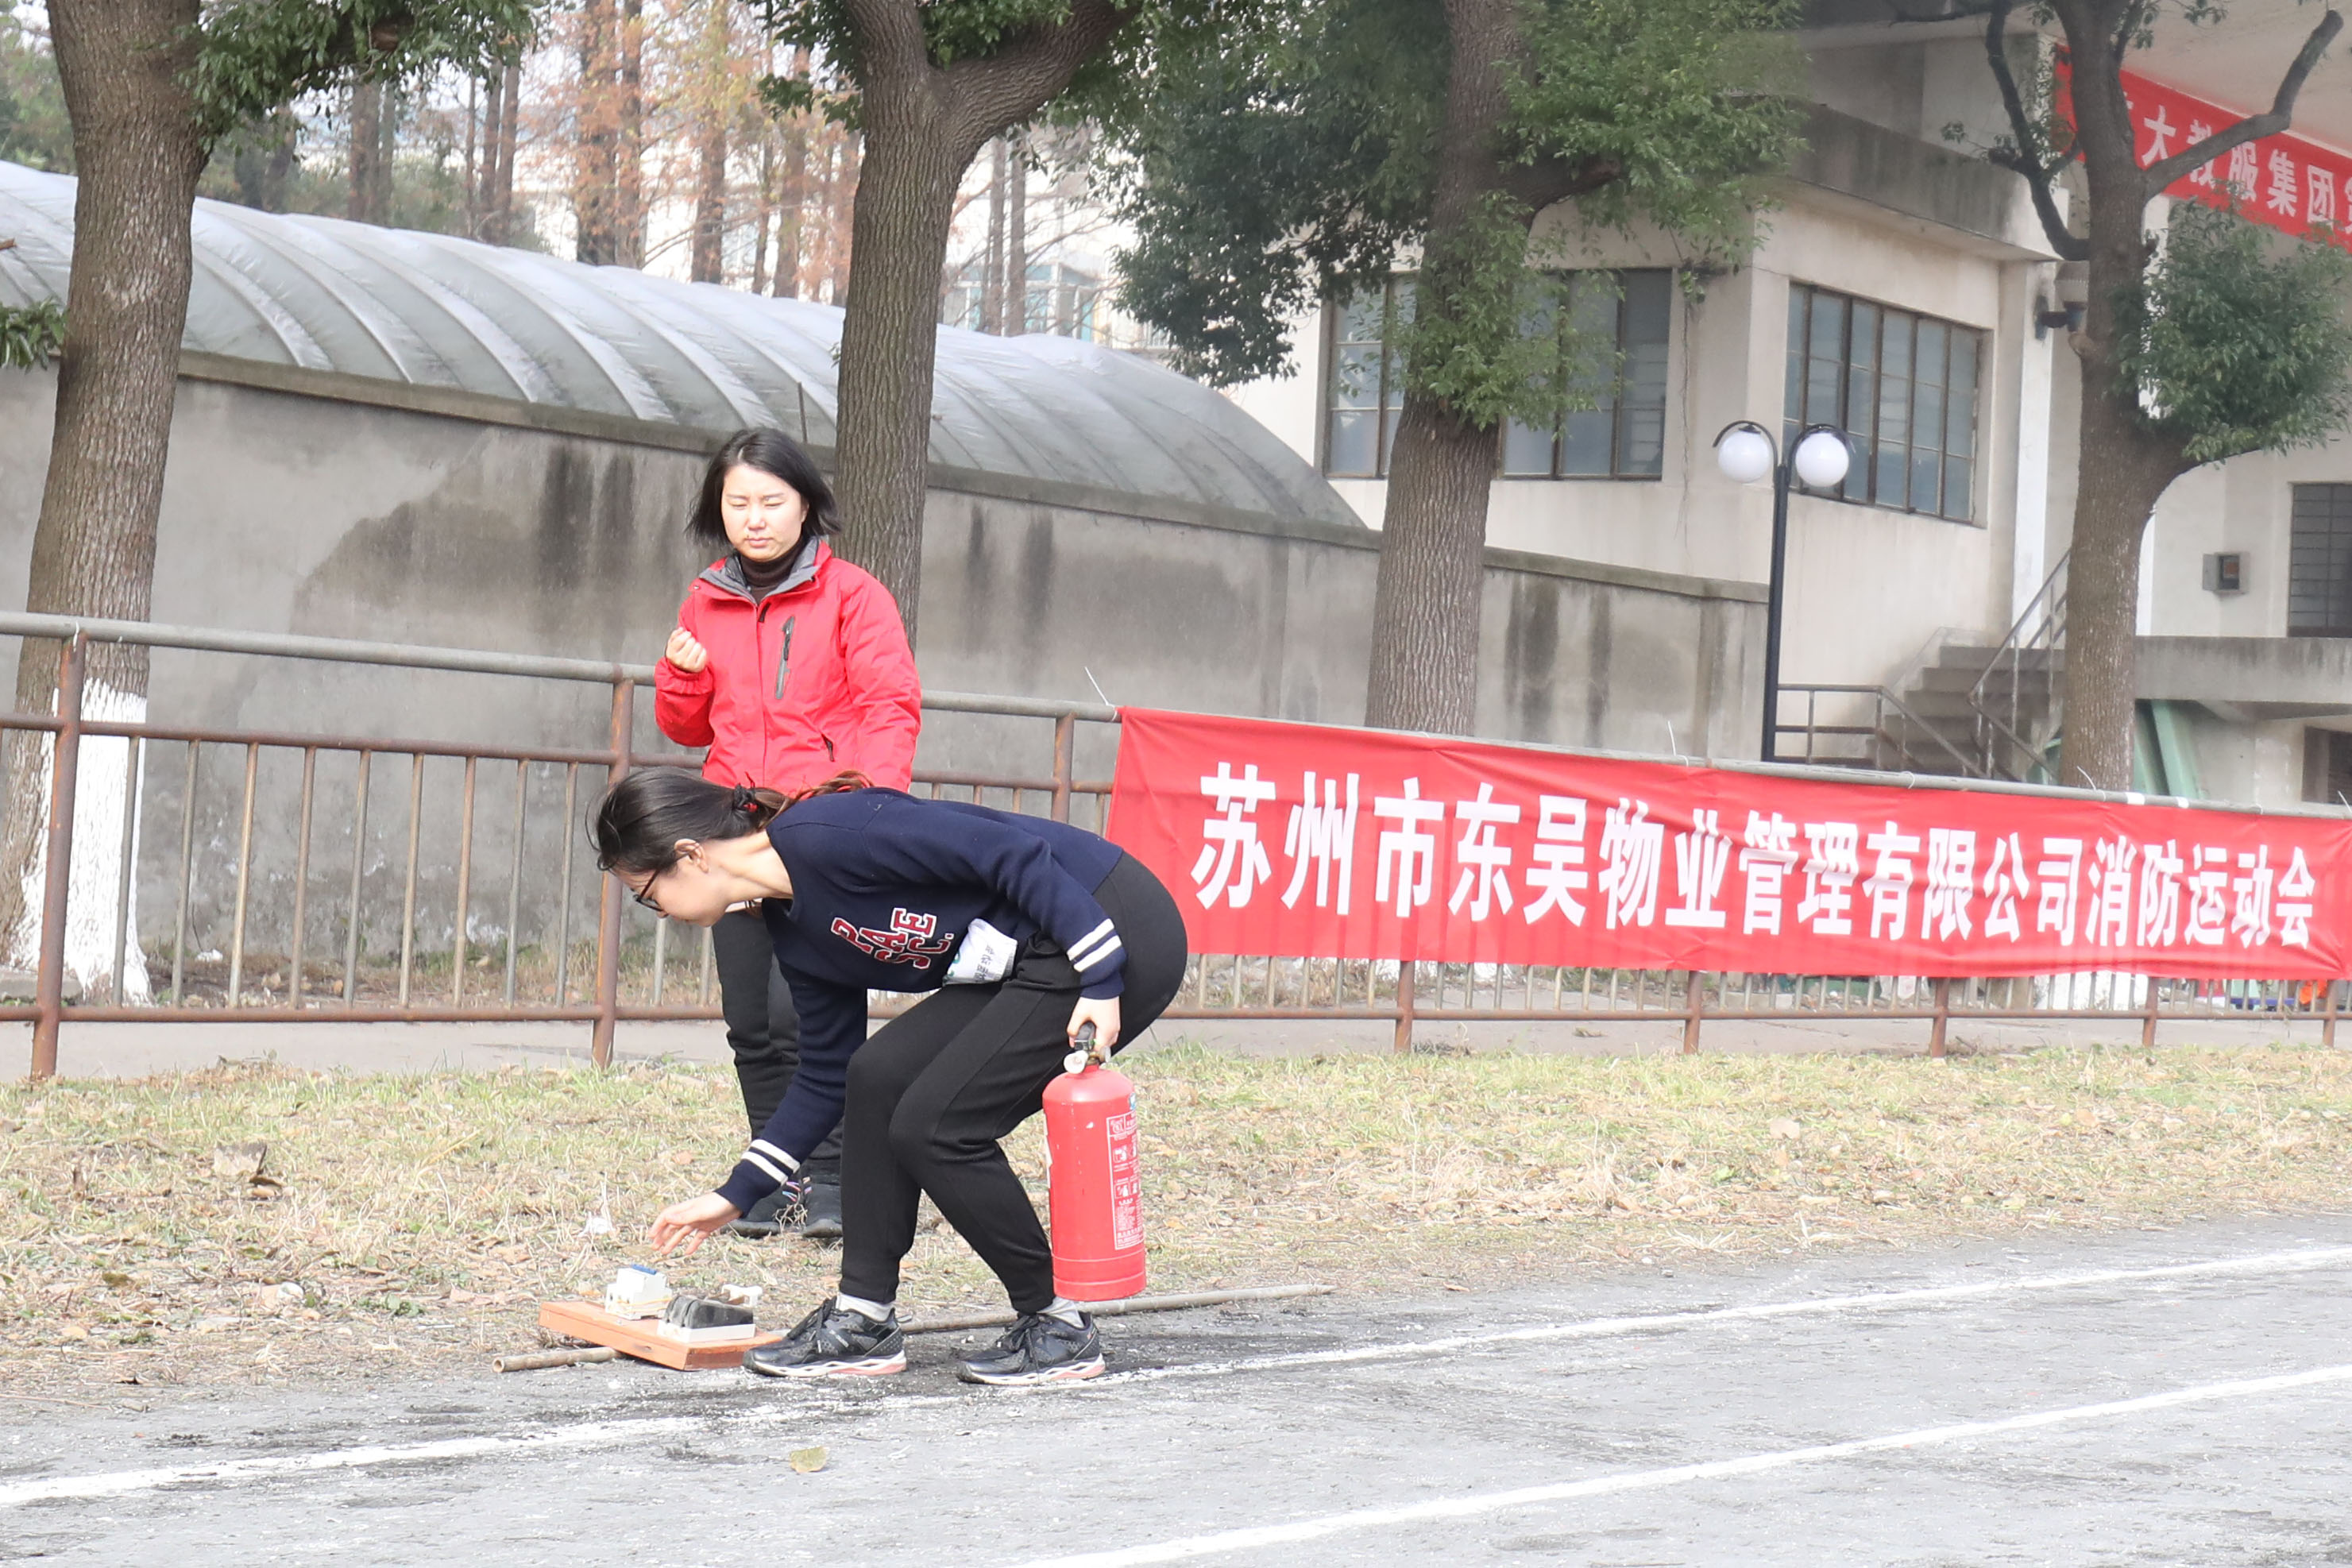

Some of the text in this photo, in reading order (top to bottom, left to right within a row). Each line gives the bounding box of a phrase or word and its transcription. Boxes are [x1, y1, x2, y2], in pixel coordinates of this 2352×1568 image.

[1190, 761, 2316, 951] 苏州市东吴物业管理有限公司消防运动会
